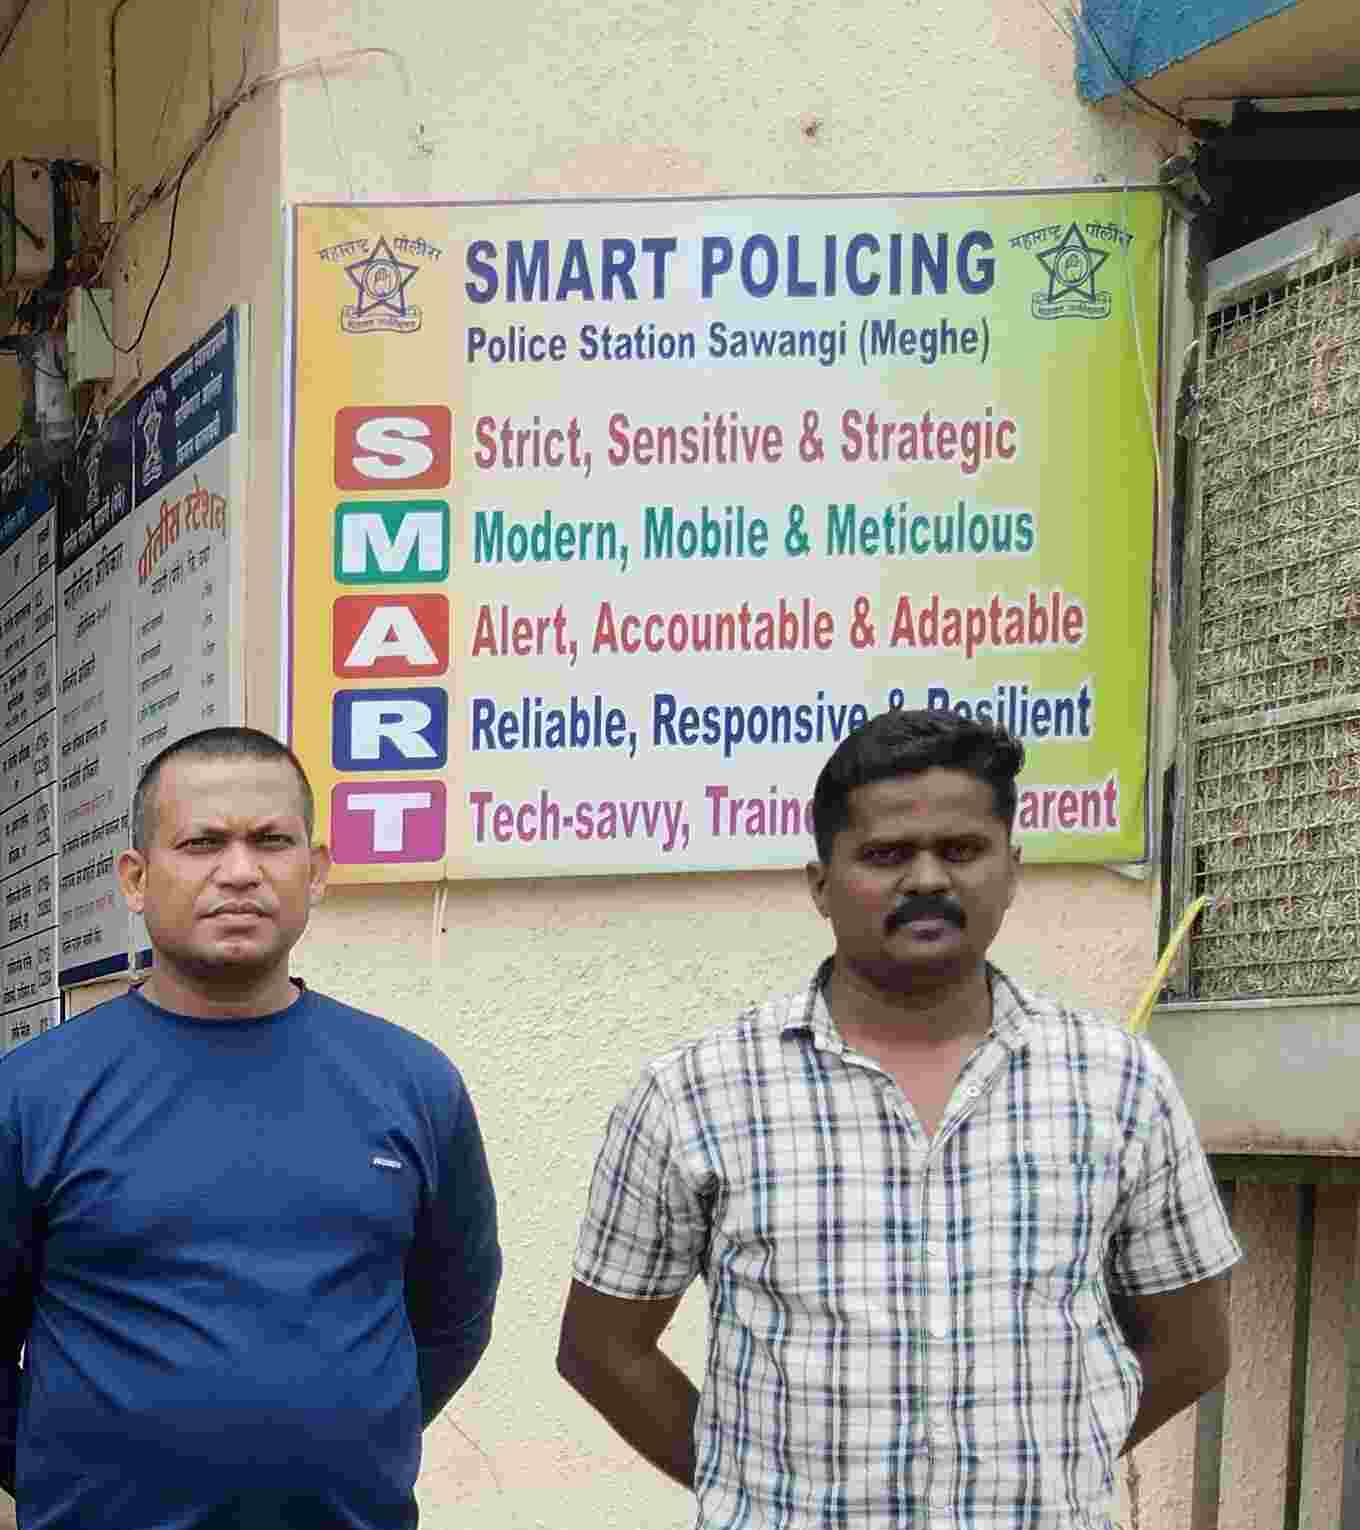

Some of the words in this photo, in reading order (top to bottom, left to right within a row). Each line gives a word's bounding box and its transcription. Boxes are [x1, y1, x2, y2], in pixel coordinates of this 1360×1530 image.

[464, 237, 678, 305] SMART
[700, 230, 997, 299] POLICING
[466, 325, 568, 364] Police
[579, 322, 696, 361] Station
[708, 319, 848, 367] Sawangi
[859, 316, 992, 366] (Meghe)
[351, 416, 434, 480] S
[473, 415, 592, 479] Strict,
[607, 411, 784, 465] Sensitive
[798, 409, 824, 463] &
[840, 405, 1018, 474] Strategic
[342, 511, 444, 574] M
[473, 509, 630, 573] Modern,
[644, 505, 769, 560] Mobile
[784, 504, 811, 557] &
[827, 500, 1034, 557] Meticulous
[343, 606, 440, 667] A
[471, 604, 578, 668] Alert,
[593, 597, 834, 656] Accountable
[849, 596, 875, 649] &
[890, 590, 1084, 659] Adaptable
[350, 700, 439, 760] R
[471, 694, 638, 758] Reliable,
[653, 690, 869, 758] Responsive
[347, 792, 431, 853] T
[470, 789, 690, 860] Tech-savvy,
[705, 785, 817, 837] Train
